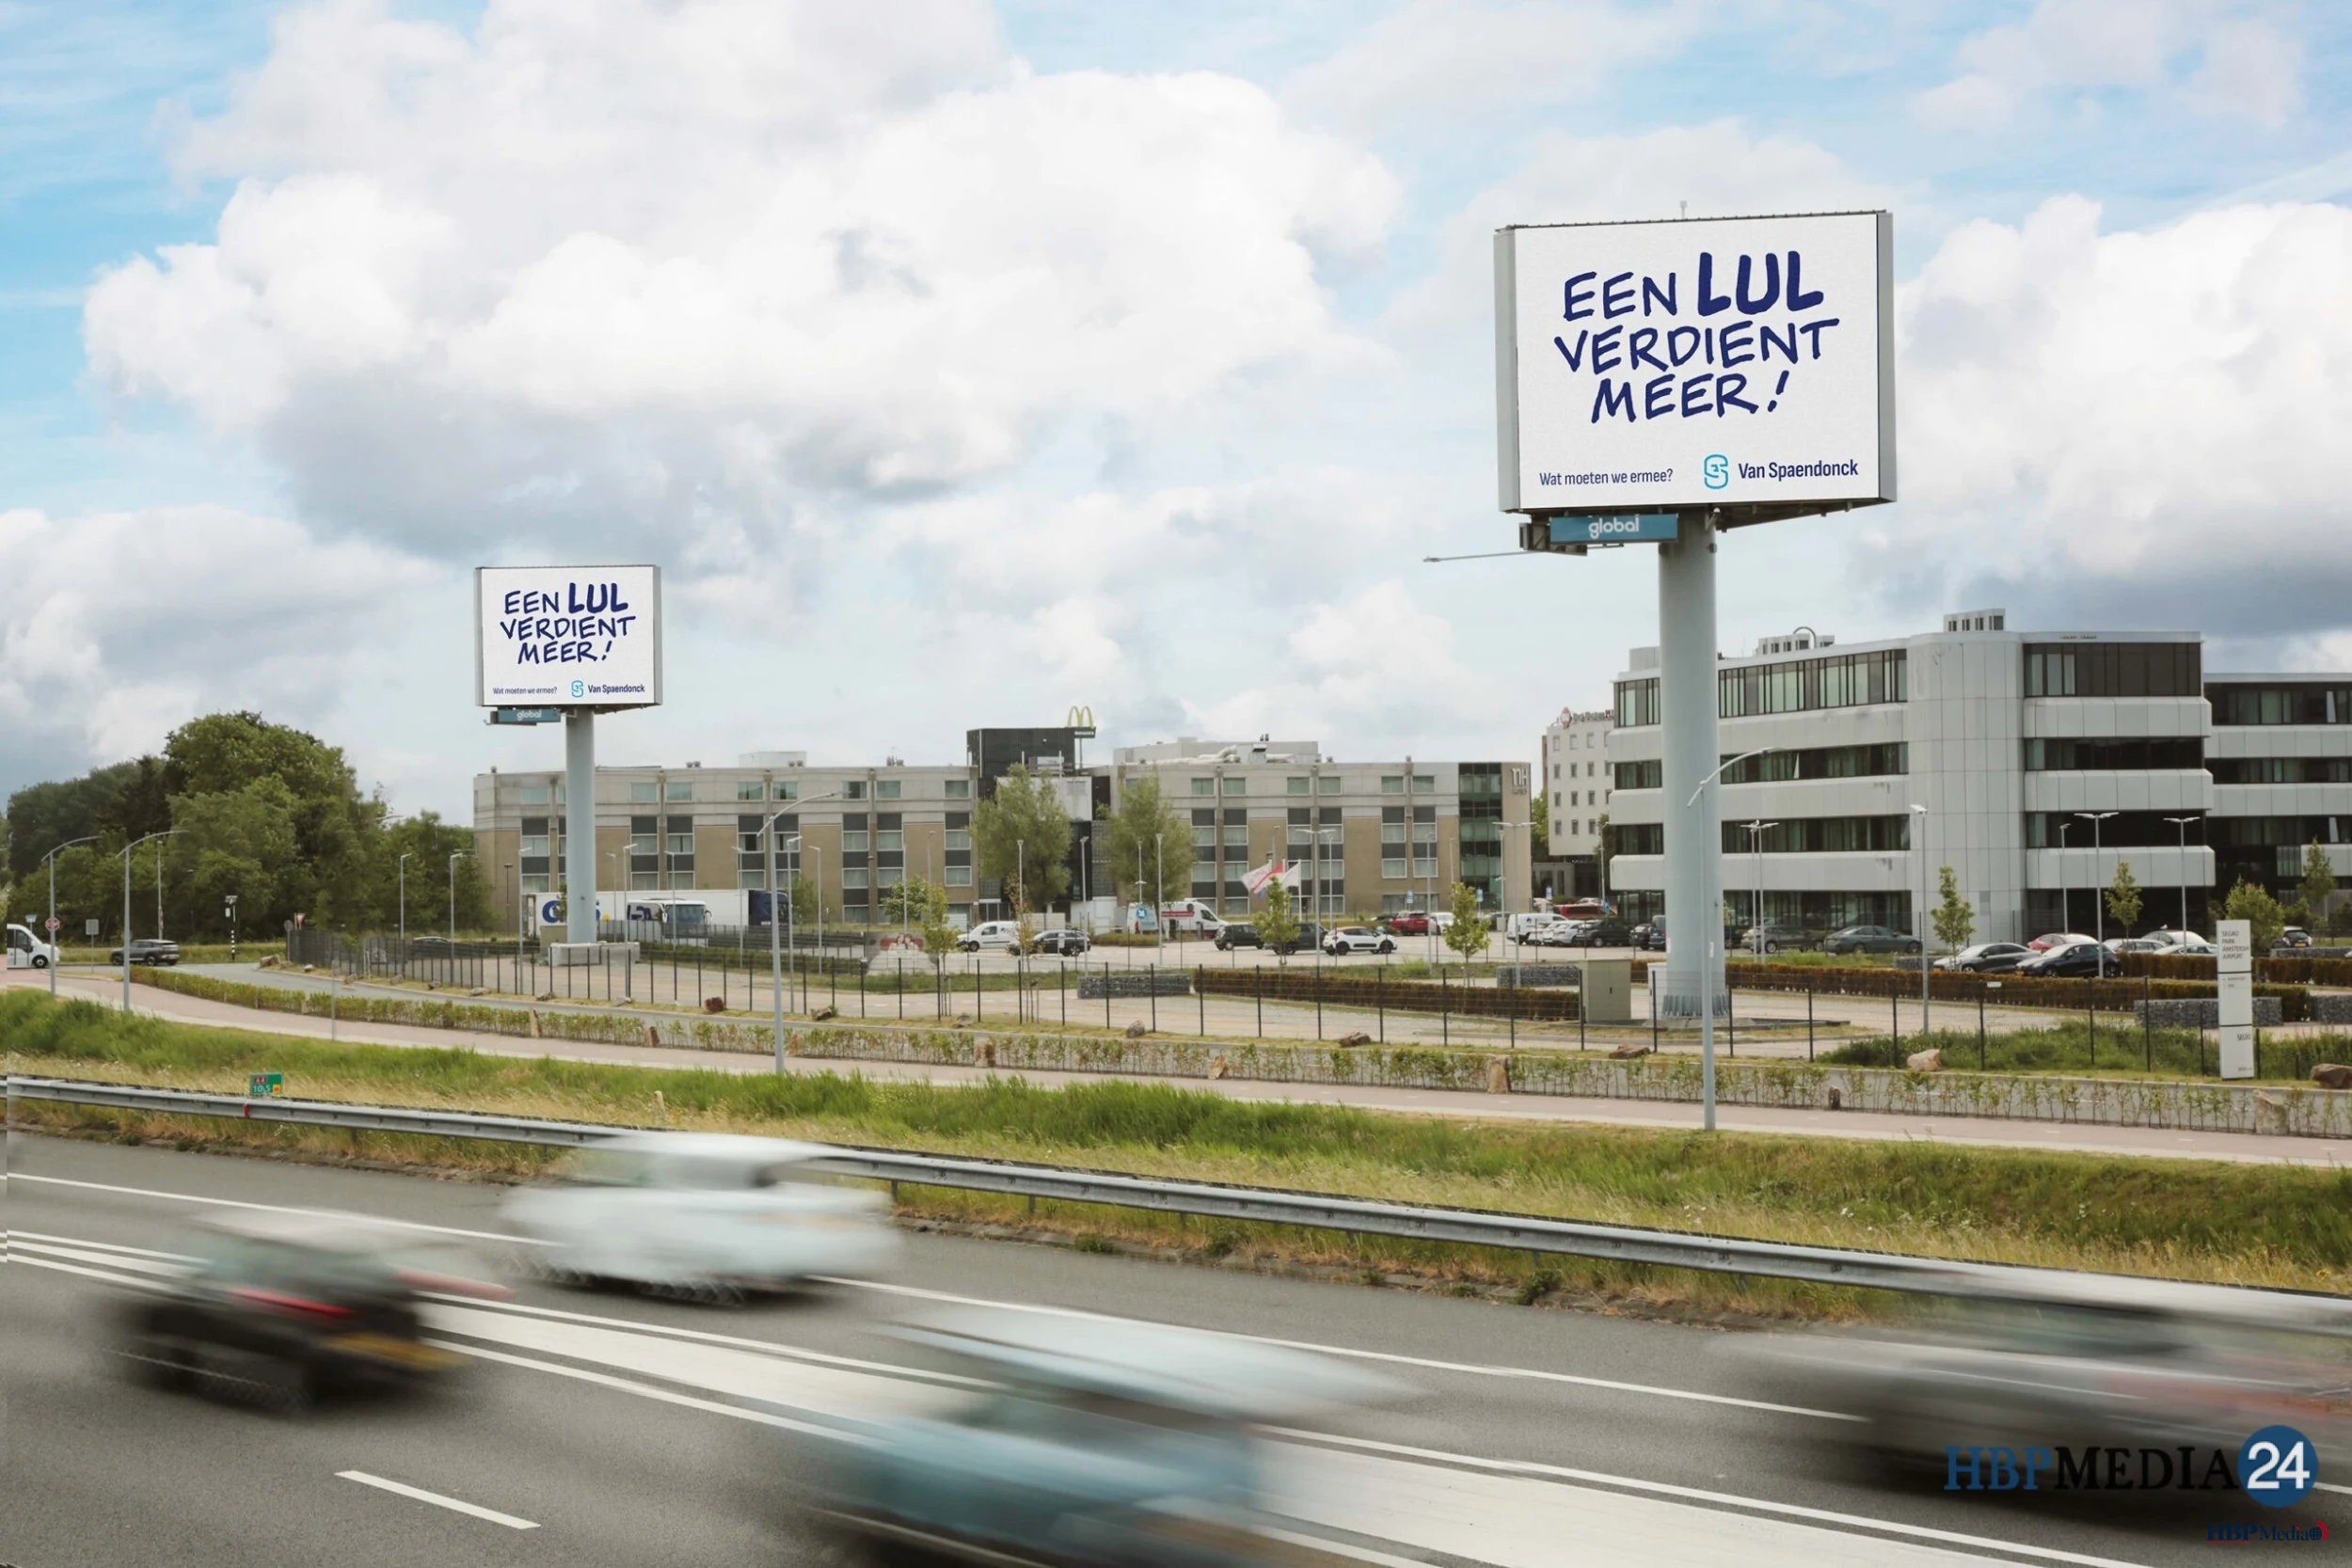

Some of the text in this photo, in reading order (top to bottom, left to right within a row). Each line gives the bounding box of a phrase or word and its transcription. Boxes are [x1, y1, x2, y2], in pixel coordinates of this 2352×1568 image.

[1563, 250, 1824, 322] EEN LUL
[1554, 318, 1840, 375] VERDIENT
[1591, 371, 1789, 423] MEER!
[1539, 468, 1674, 486] Wat moeten we ermee?
[1739, 458, 1859, 482] Van Spaendonck
[1588, 516, 1640, 539] global
[504, 582, 628, 614] EEN LUL
[500, 616, 636, 641] VERDIENT
[517, 641, 612, 664] MEER!
[588, 684, 645, 695] Van Spaendonck
[516, 709, 542, 721] global
